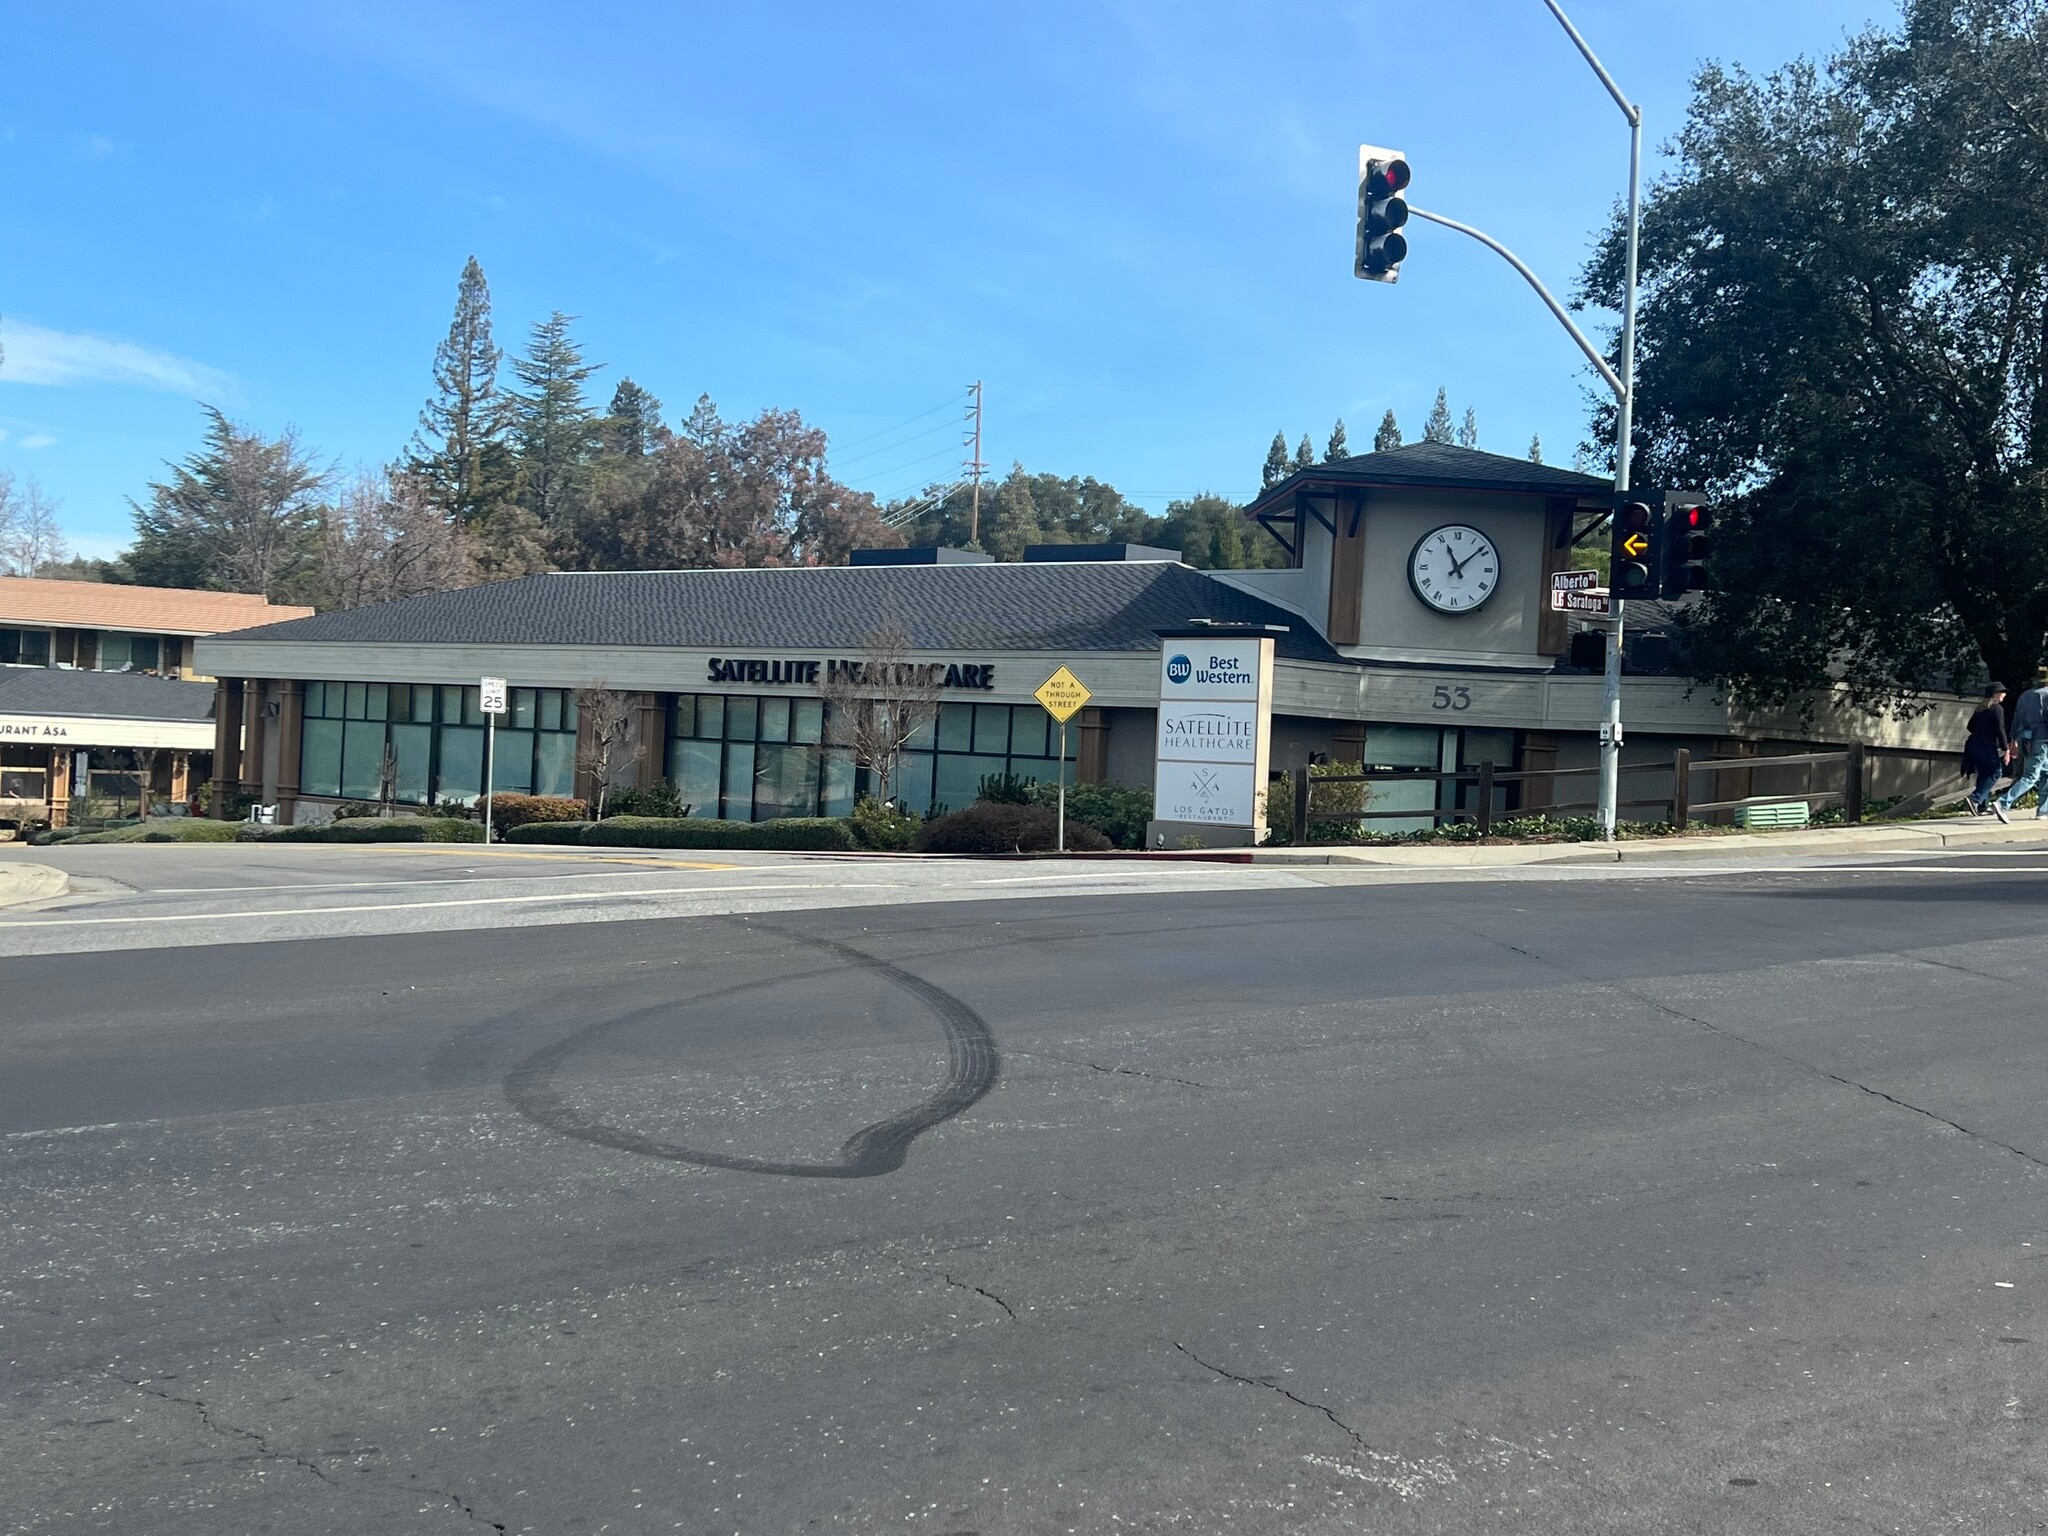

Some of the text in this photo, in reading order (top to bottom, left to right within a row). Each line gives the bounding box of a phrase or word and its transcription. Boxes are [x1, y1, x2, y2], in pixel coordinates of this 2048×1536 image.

[1554, 574, 1589, 589] Alberto
[1553, 592, 1565, 607] LG
[1567, 594, 1602, 611] Saratoga
[1210, 656, 1239, 669] Best
[708, 658, 821, 684] SATELLITE
[1170, 664, 1190, 677] BW
[1196, 670, 1251, 684] Western
[484, 695, 503, 709] 25
[1432, 685, 1471, 710] 53
[42, 725, 67, 736] ASA
[1165, 737, 1251, 749] HEALTHCARE
[1202, 768, 1208, 777] S
[1174, 805, 1235, 816] LOS GATOS
[1179, 813, 1228, 821] RESTAURANT
